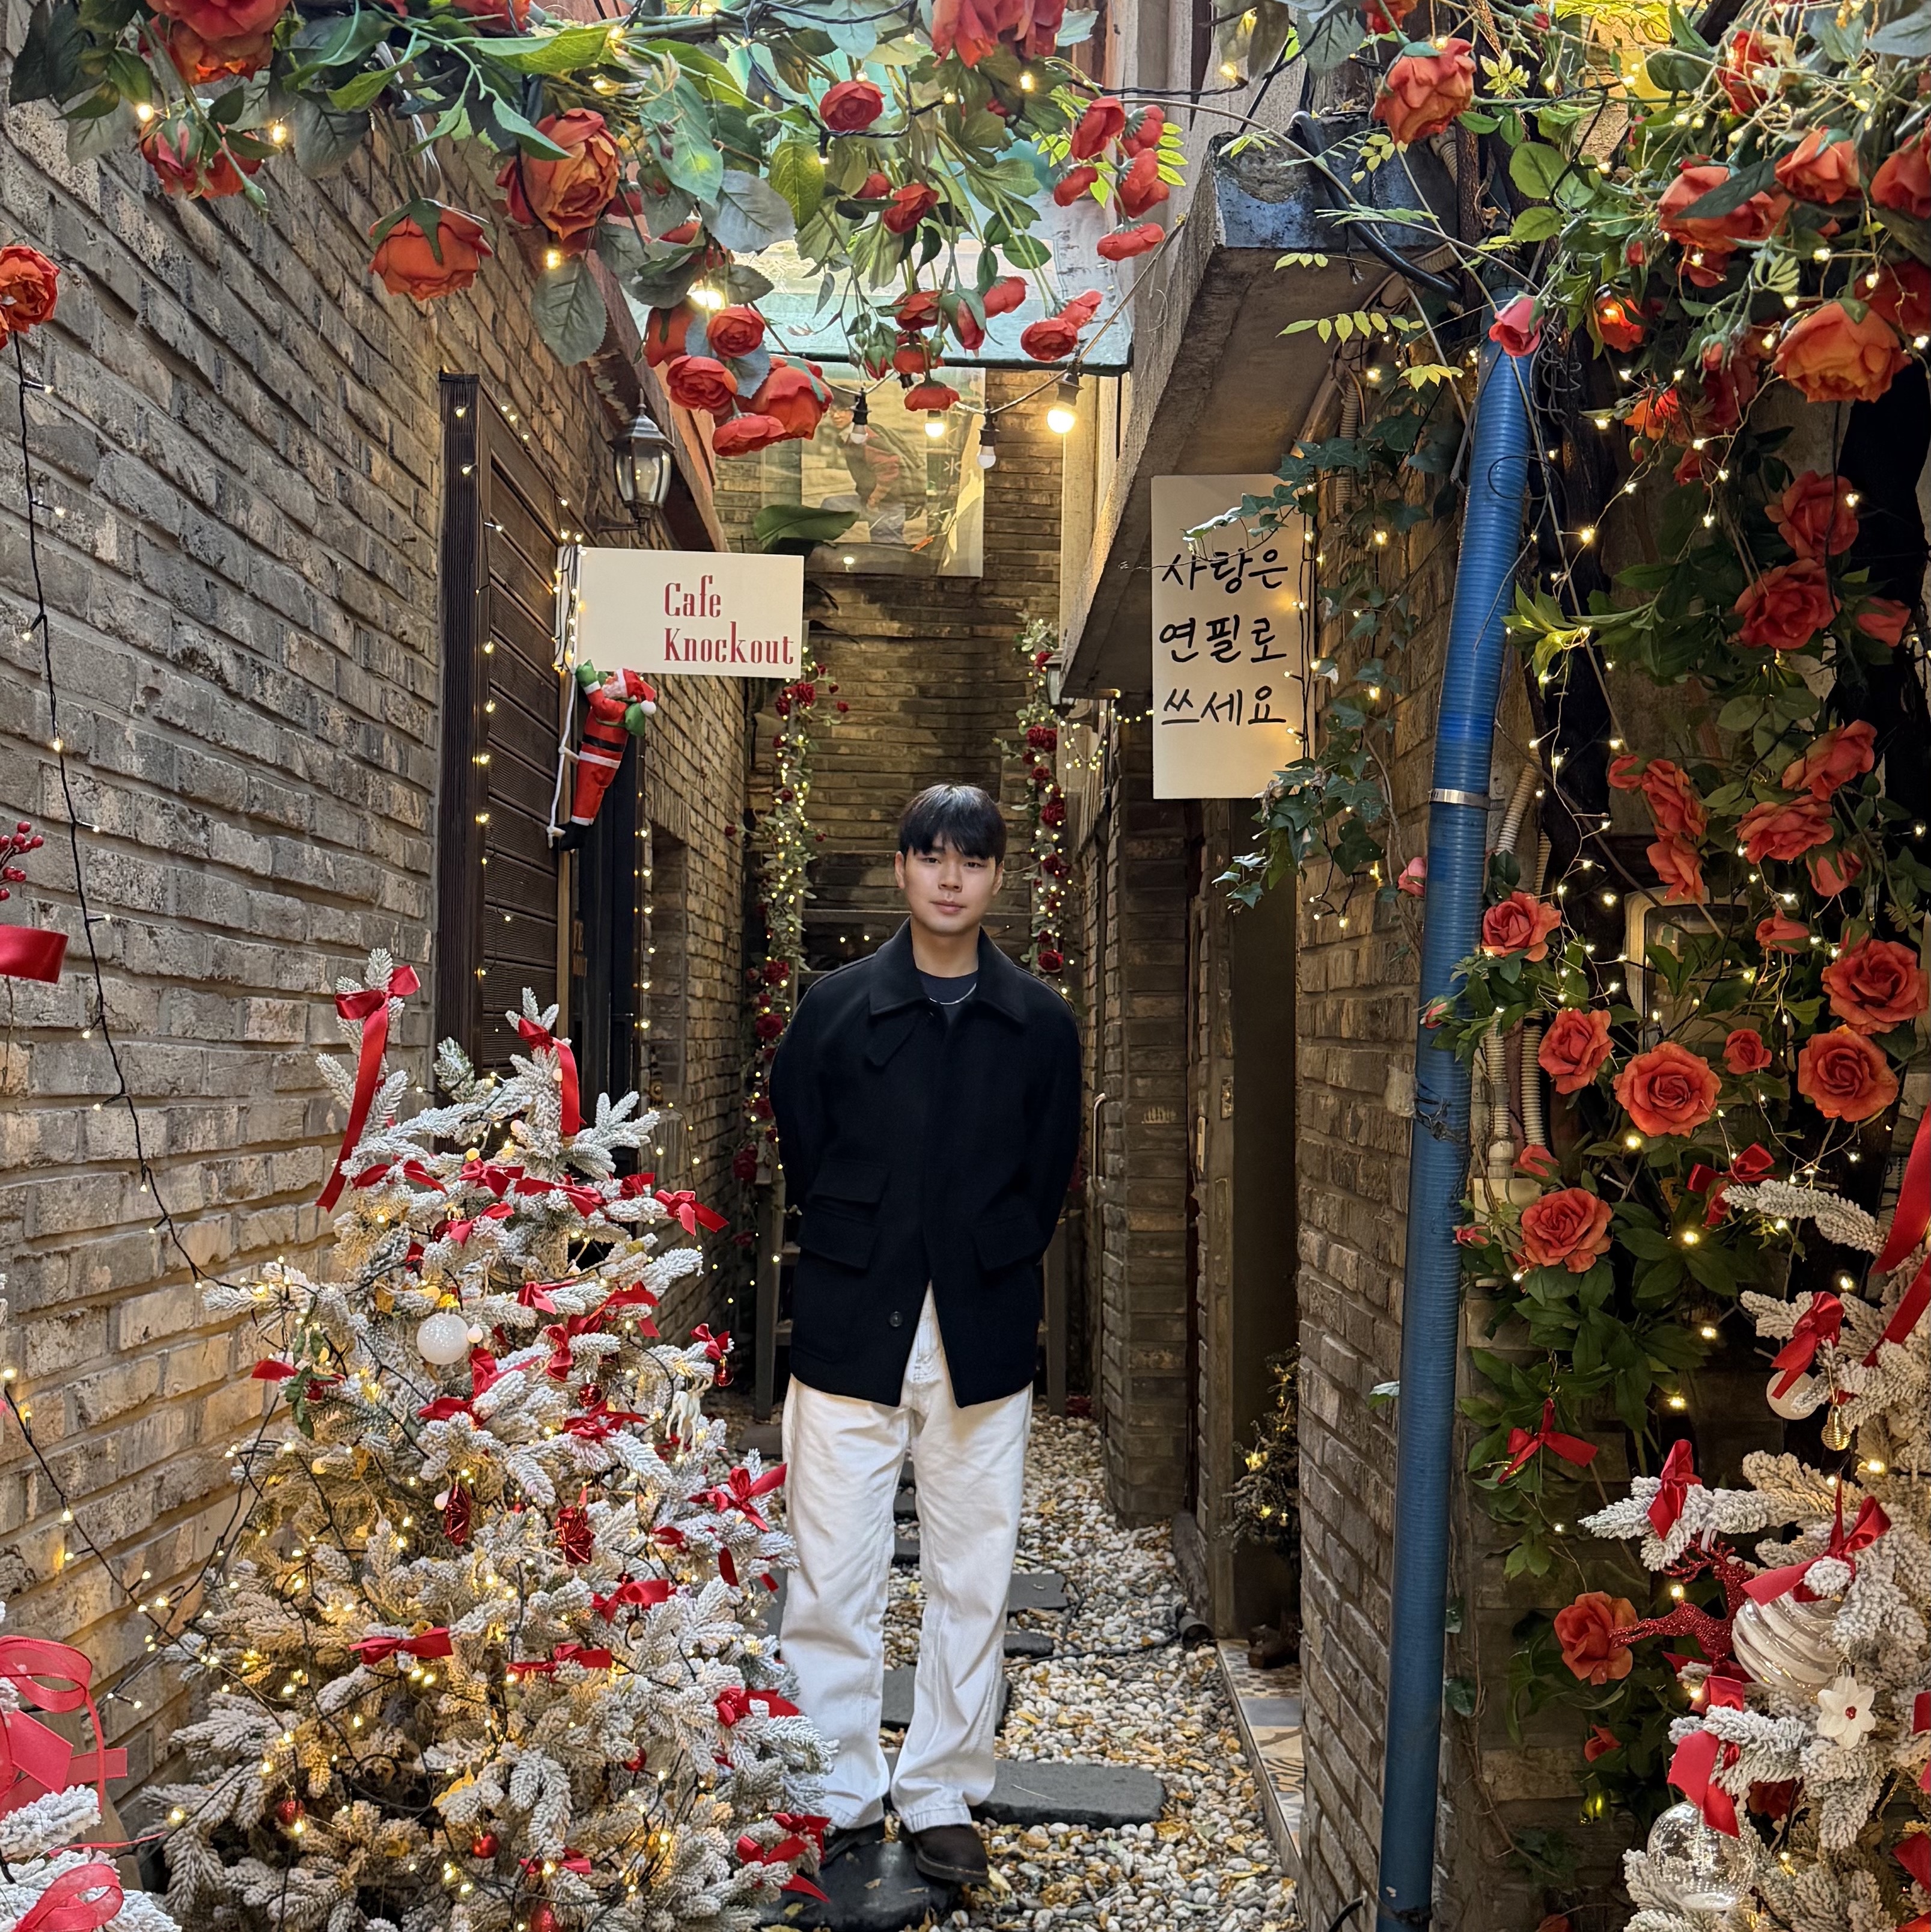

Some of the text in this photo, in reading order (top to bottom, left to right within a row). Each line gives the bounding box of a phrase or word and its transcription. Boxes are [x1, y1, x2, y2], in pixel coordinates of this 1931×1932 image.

[1161, 548, 1289, 594] 사랑은
[664, 575, 721, 618] Cafe
[663, 621, 794, 665] Knockout
[1159, 613, 1287, 663] 연필로
[1161, 685, 1287, 726] 쓰세요
